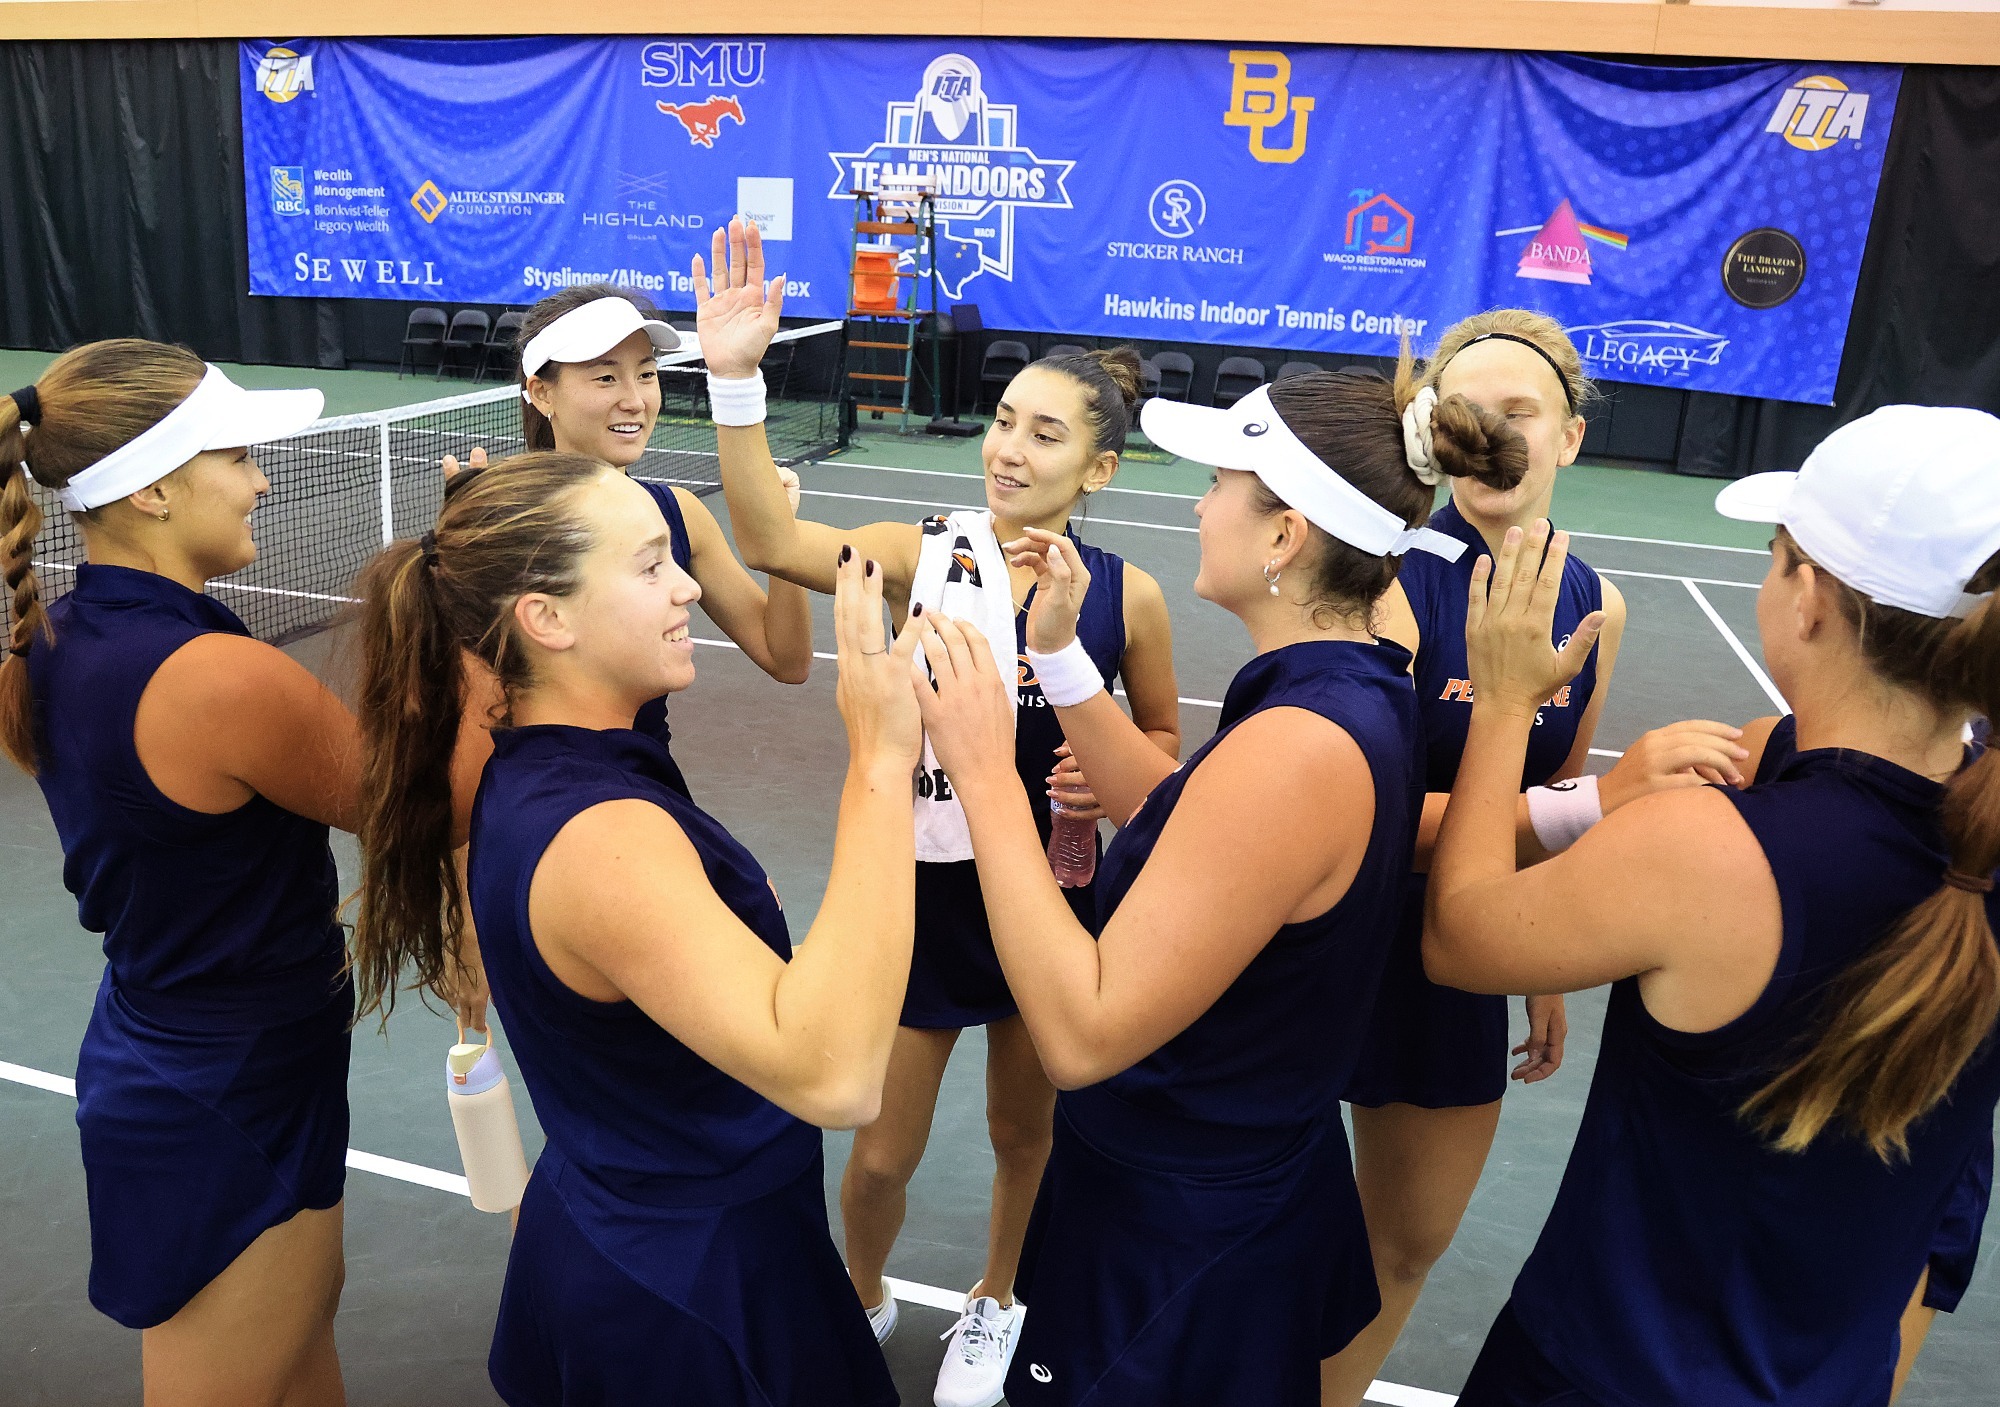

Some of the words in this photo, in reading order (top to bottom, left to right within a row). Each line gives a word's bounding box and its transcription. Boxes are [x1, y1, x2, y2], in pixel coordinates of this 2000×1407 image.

[641, 41, 766, 87] SMU
[255, 54, 314, 92] ITA
[931, 76, 972, 97] ITA
[1223, 50, 1316, 164] BU
[1765, 87, 1870, 140] ITA
[908, 150, 939, 162] MEN'S
[941, 152, 990, 165] NATIONAL
[313, 169, 353, 181] Wealth
[851, 161, 918, 193] TEAM
[926, 164, 1046, 199] INDOORS
[314, 185, 386, 200] Management
[276, 201, 302, 212] RBC
[449, 205, 532, 216] FOUNDATION
[628, 200, 657, 211] THE
[314, 220, 353, 235] Legacy
[354, 221, 390, 233] Wealth
[582, 212, 704, 229] HIGHLAND
[974, 227, 996, 238] WACO
[1107, 242, 1178, 261] STICKER
[1182, 246, 1244, 265] RANCH
[1323, 253, 1356, 264] WACO
[1356, 255, 1427, 269] RESTORATION
[1530, 242, 1592, 265] BANDA
[1737, 252, 1756, 264] THE
[294, 252, 444, 286] SEWELL
[1358, 265, 1404, 275] REMODELING
[1743, 263, 1785, 276] LANDING
[523, 266, 665, 291] Styslinger/Altec
[1104, 293, 1196, 321] Hawkins
[1200, 300, 1271, 326] Indoor
[1275, 304, 1346, 332] Tennis
[1351, 309, 1428, 337] Center
[1584, 334, 1700, 371] LEGACY
